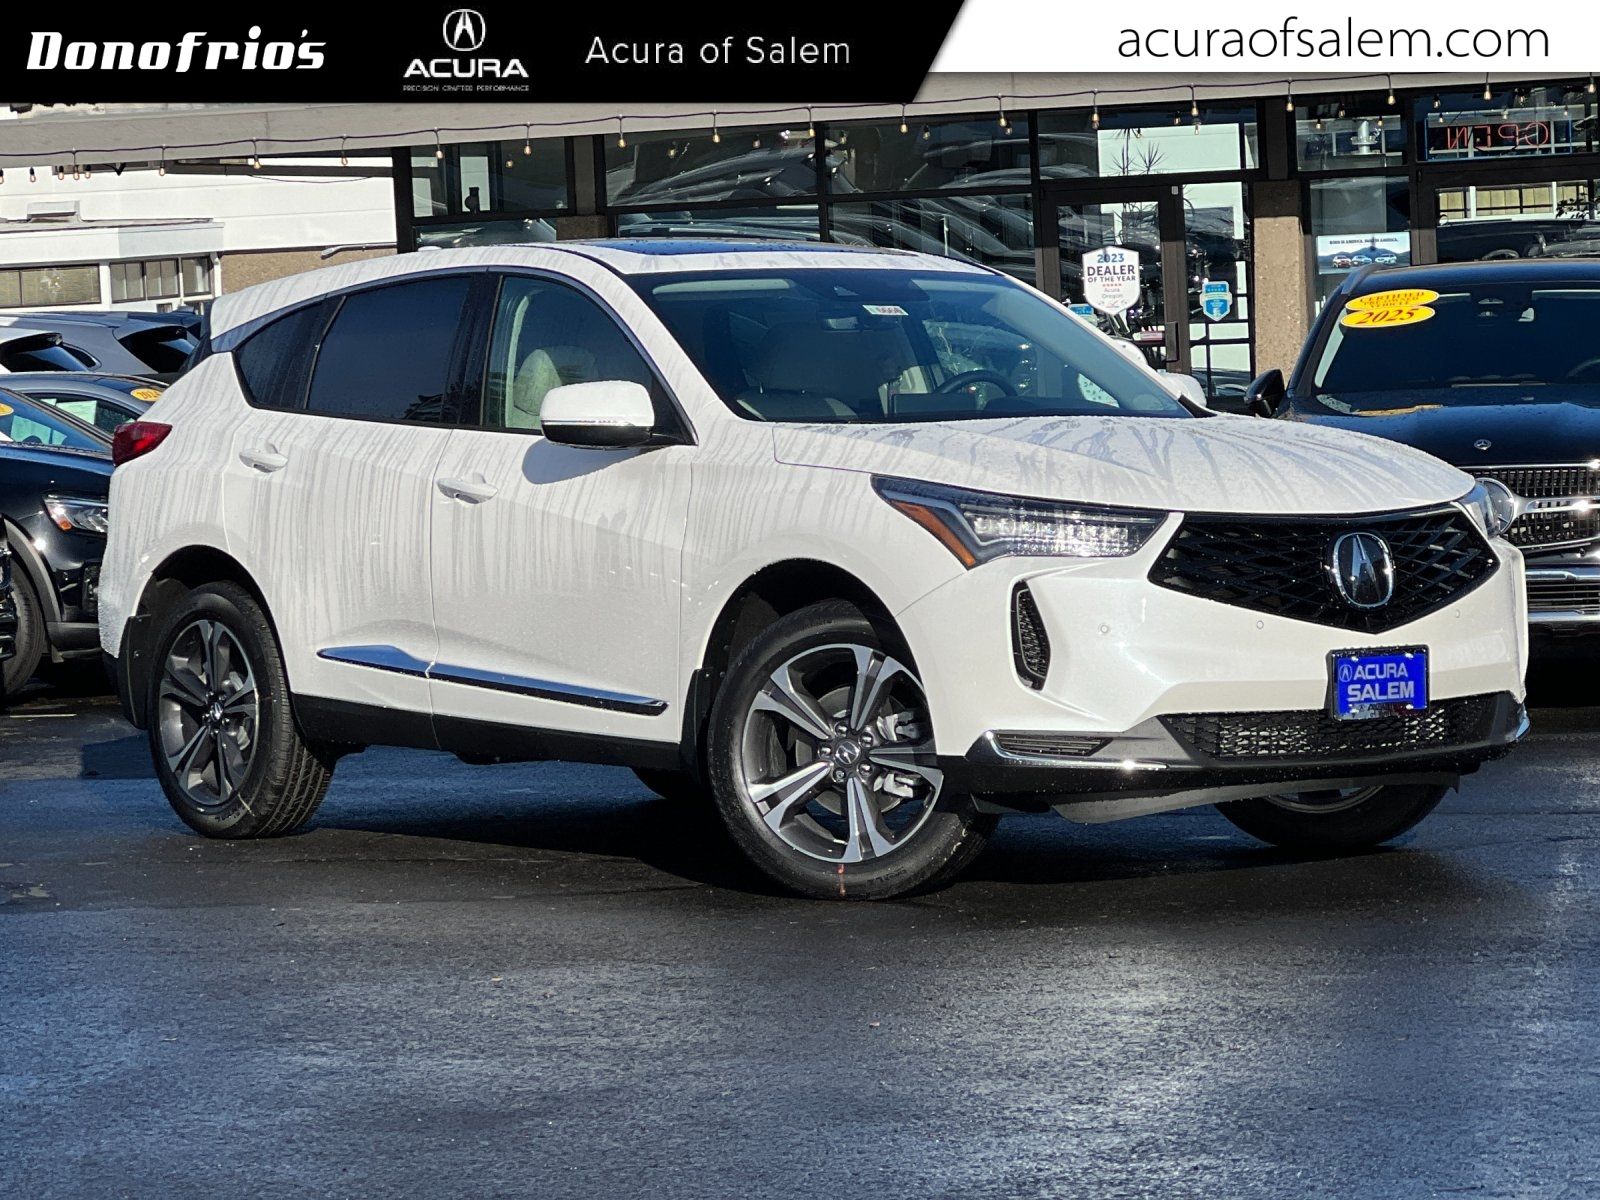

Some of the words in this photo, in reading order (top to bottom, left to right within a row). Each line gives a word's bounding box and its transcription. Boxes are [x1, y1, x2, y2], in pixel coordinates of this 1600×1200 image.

[1096, 253, 1125, 264] 2023
[1087, 264, 1136, 276] DEALER
[1355, 308, 1419, 325] 2025
[1353, 663, 1408, 680] ACURA
[1346, 681, 1415, 702] SALEM
